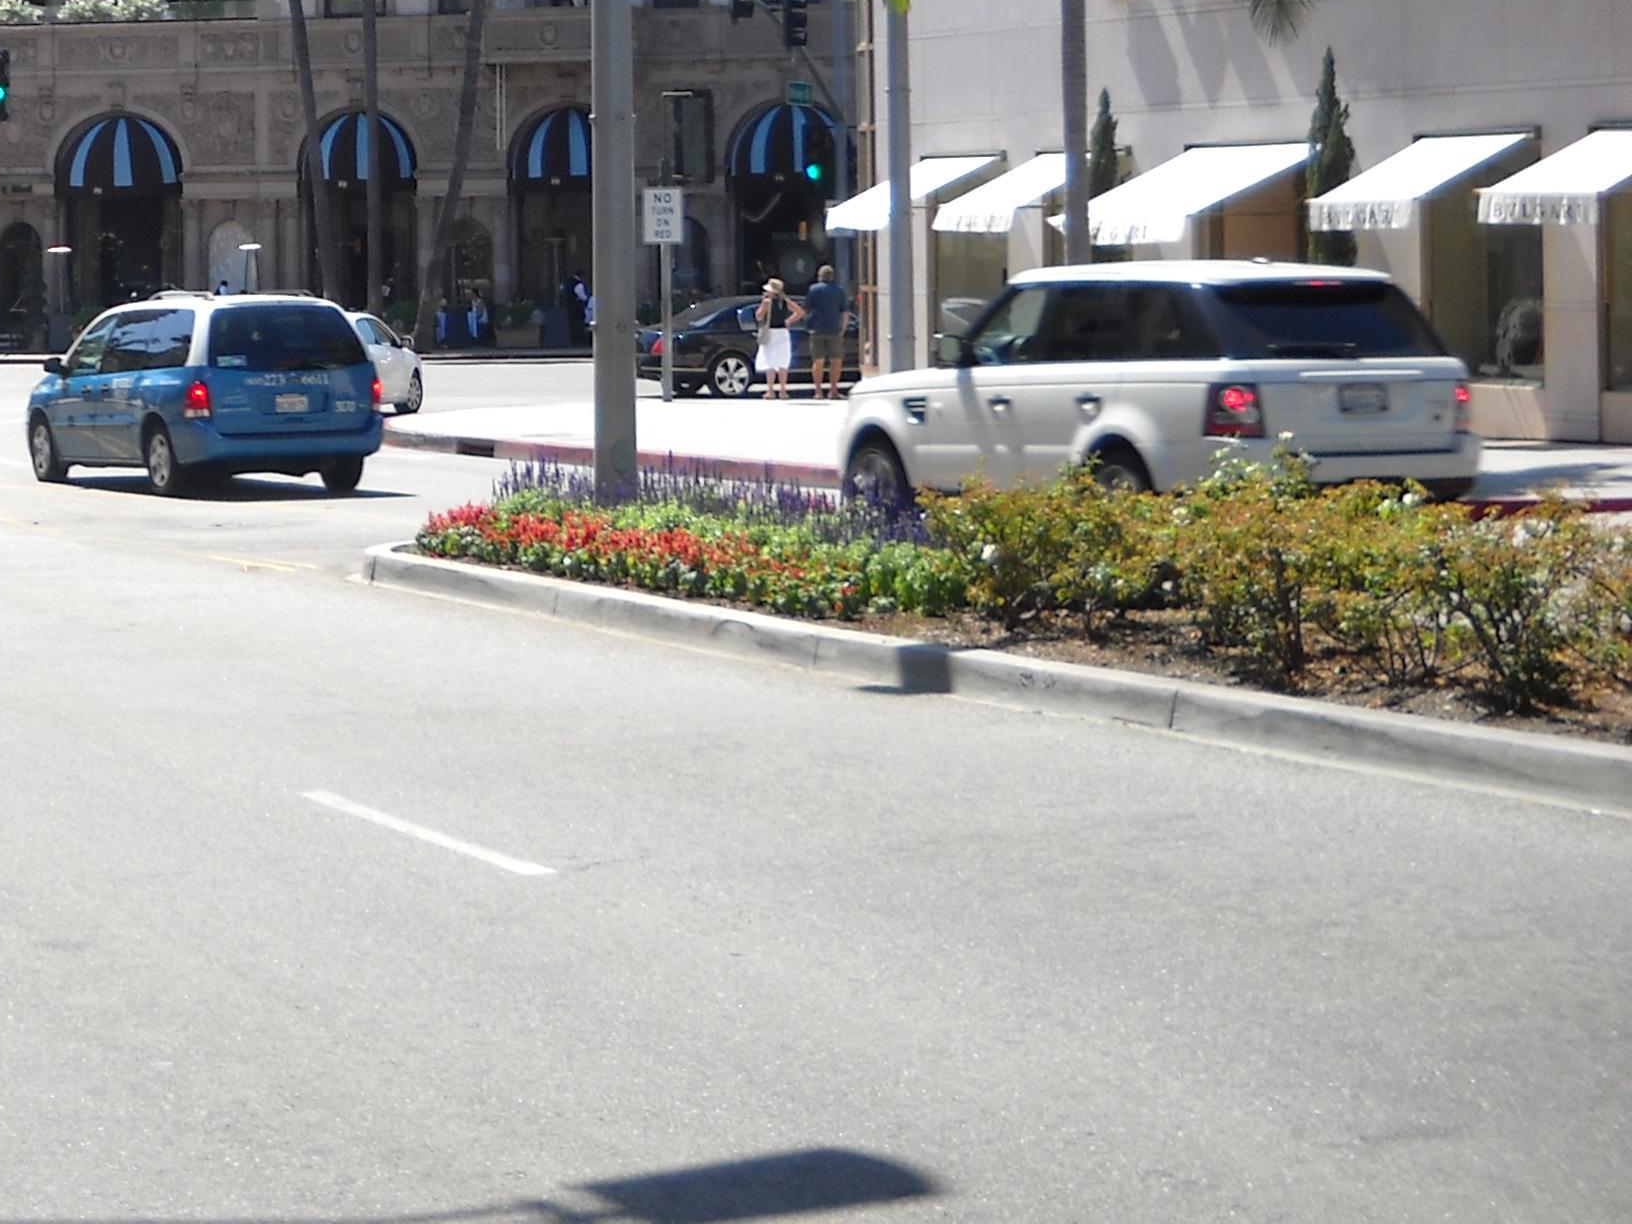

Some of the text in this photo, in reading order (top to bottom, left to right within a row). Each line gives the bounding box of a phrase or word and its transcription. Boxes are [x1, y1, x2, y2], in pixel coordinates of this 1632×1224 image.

[654, 193, 672, 203] NO
[651, 206, 674, 215] TURN
[655, 218, 669, 227] ON
[654, 229, 672, 239] RED
